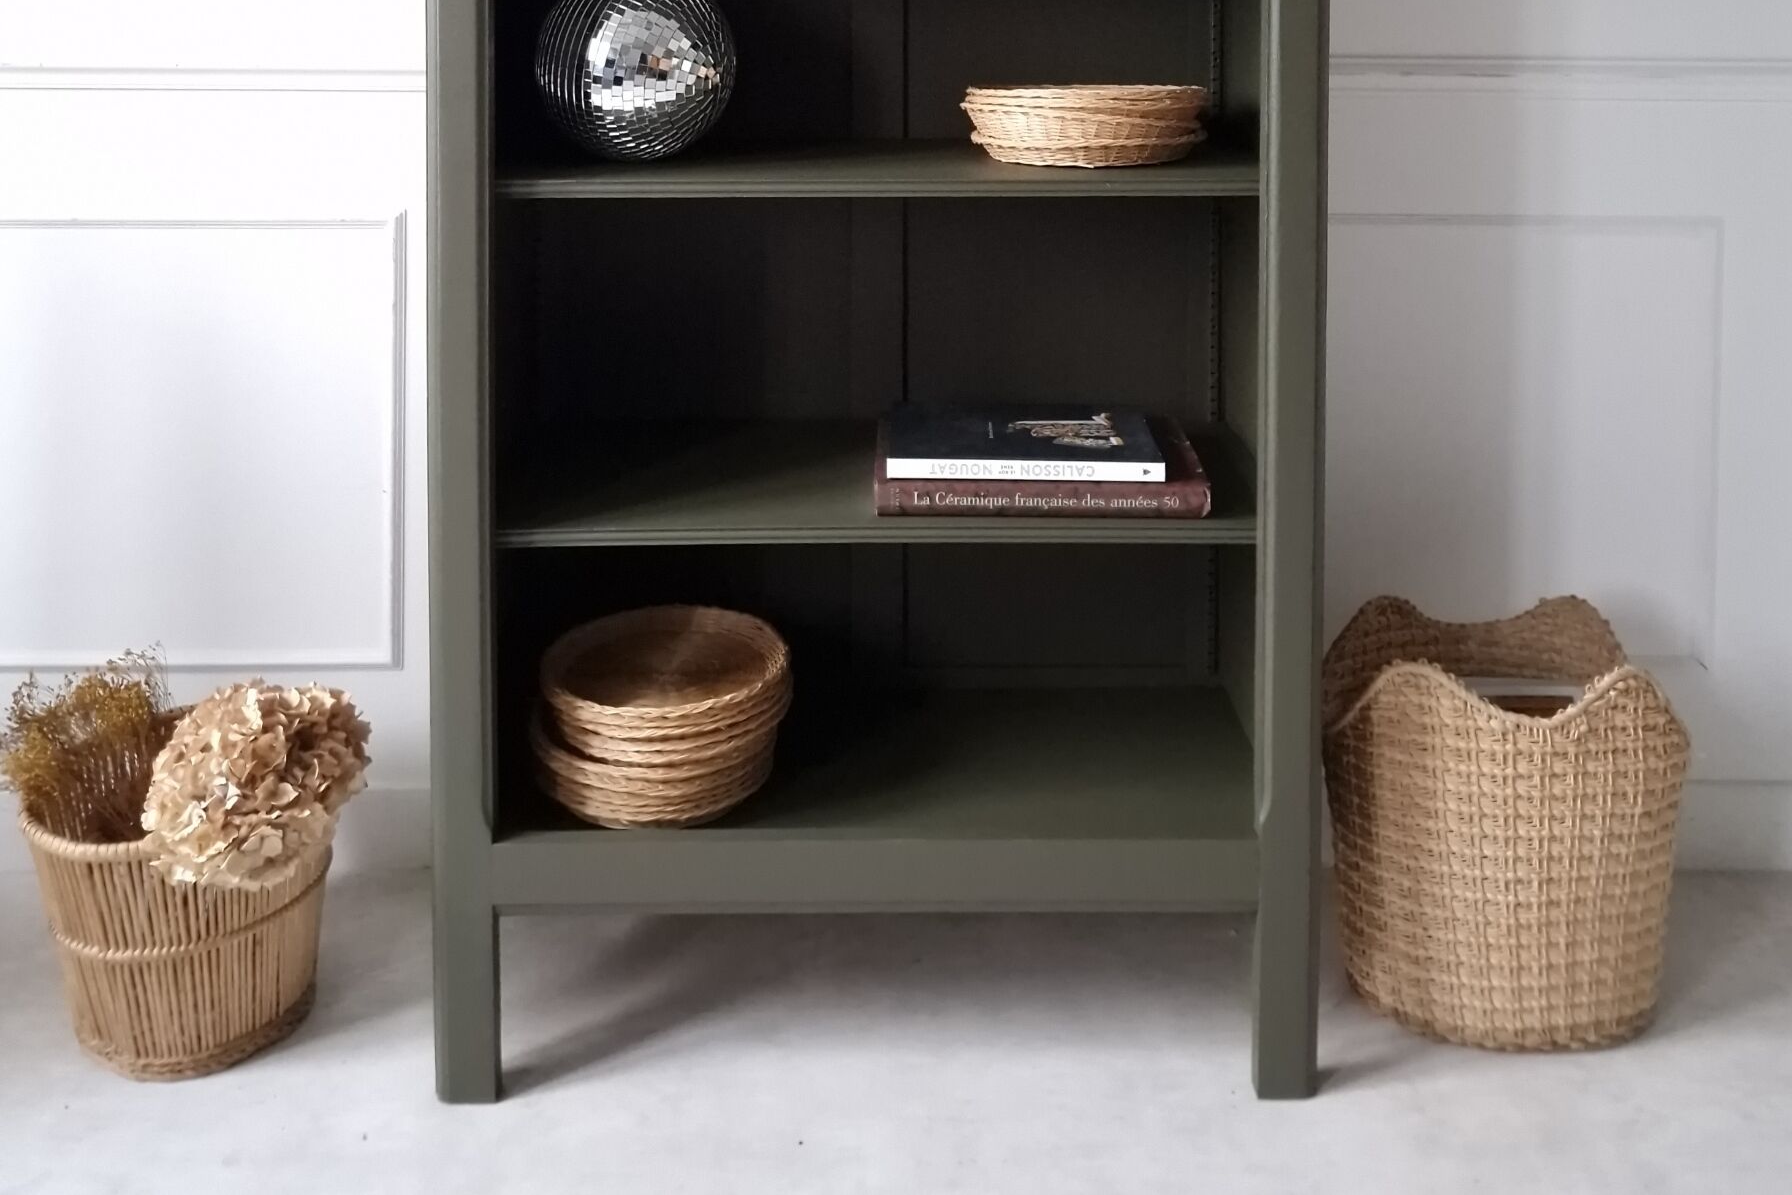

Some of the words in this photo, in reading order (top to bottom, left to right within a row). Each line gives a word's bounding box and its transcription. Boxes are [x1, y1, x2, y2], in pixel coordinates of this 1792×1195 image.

[930, 463, 993, 476] NOUGAT
[1021, 464, 1095, 477] CALISSON
[913, 491, 930, 505] La
[935, 491, 1010, 508] Céramique
[1015, 493, 1077, 509] française
[1082, 494, 1105, 507] des
[1110, 496, 1158, 508] années
[1163, 496, 1180, 508] 50
